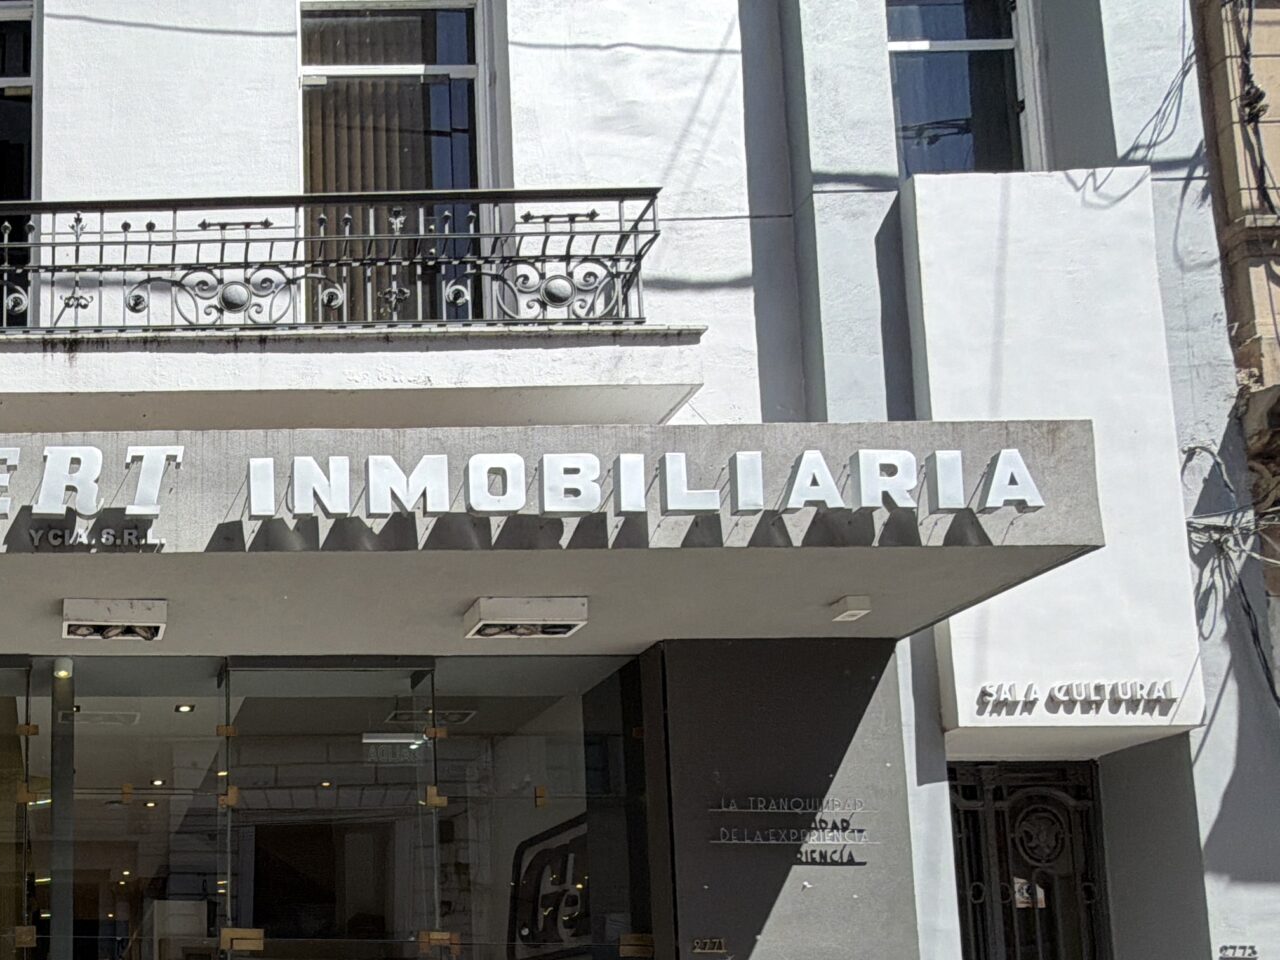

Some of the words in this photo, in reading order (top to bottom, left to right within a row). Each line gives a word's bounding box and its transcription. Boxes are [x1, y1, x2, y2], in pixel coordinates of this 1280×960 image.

[245, 447, 1046, 518] INMOBILIARIA
[979, 681, 1040, 703] SALA
[1049, 680, 1178, 703] CULTURAL
[721, 797, 738, 811] LA
[721, 827, 738, 842] DE
[744, 828, 765, 842] LA
[770, 829, 870, 844] EXPERIENCIA
[693, 937, 726, 951] 2771
[1219, 944, 1258, 958] 2773
